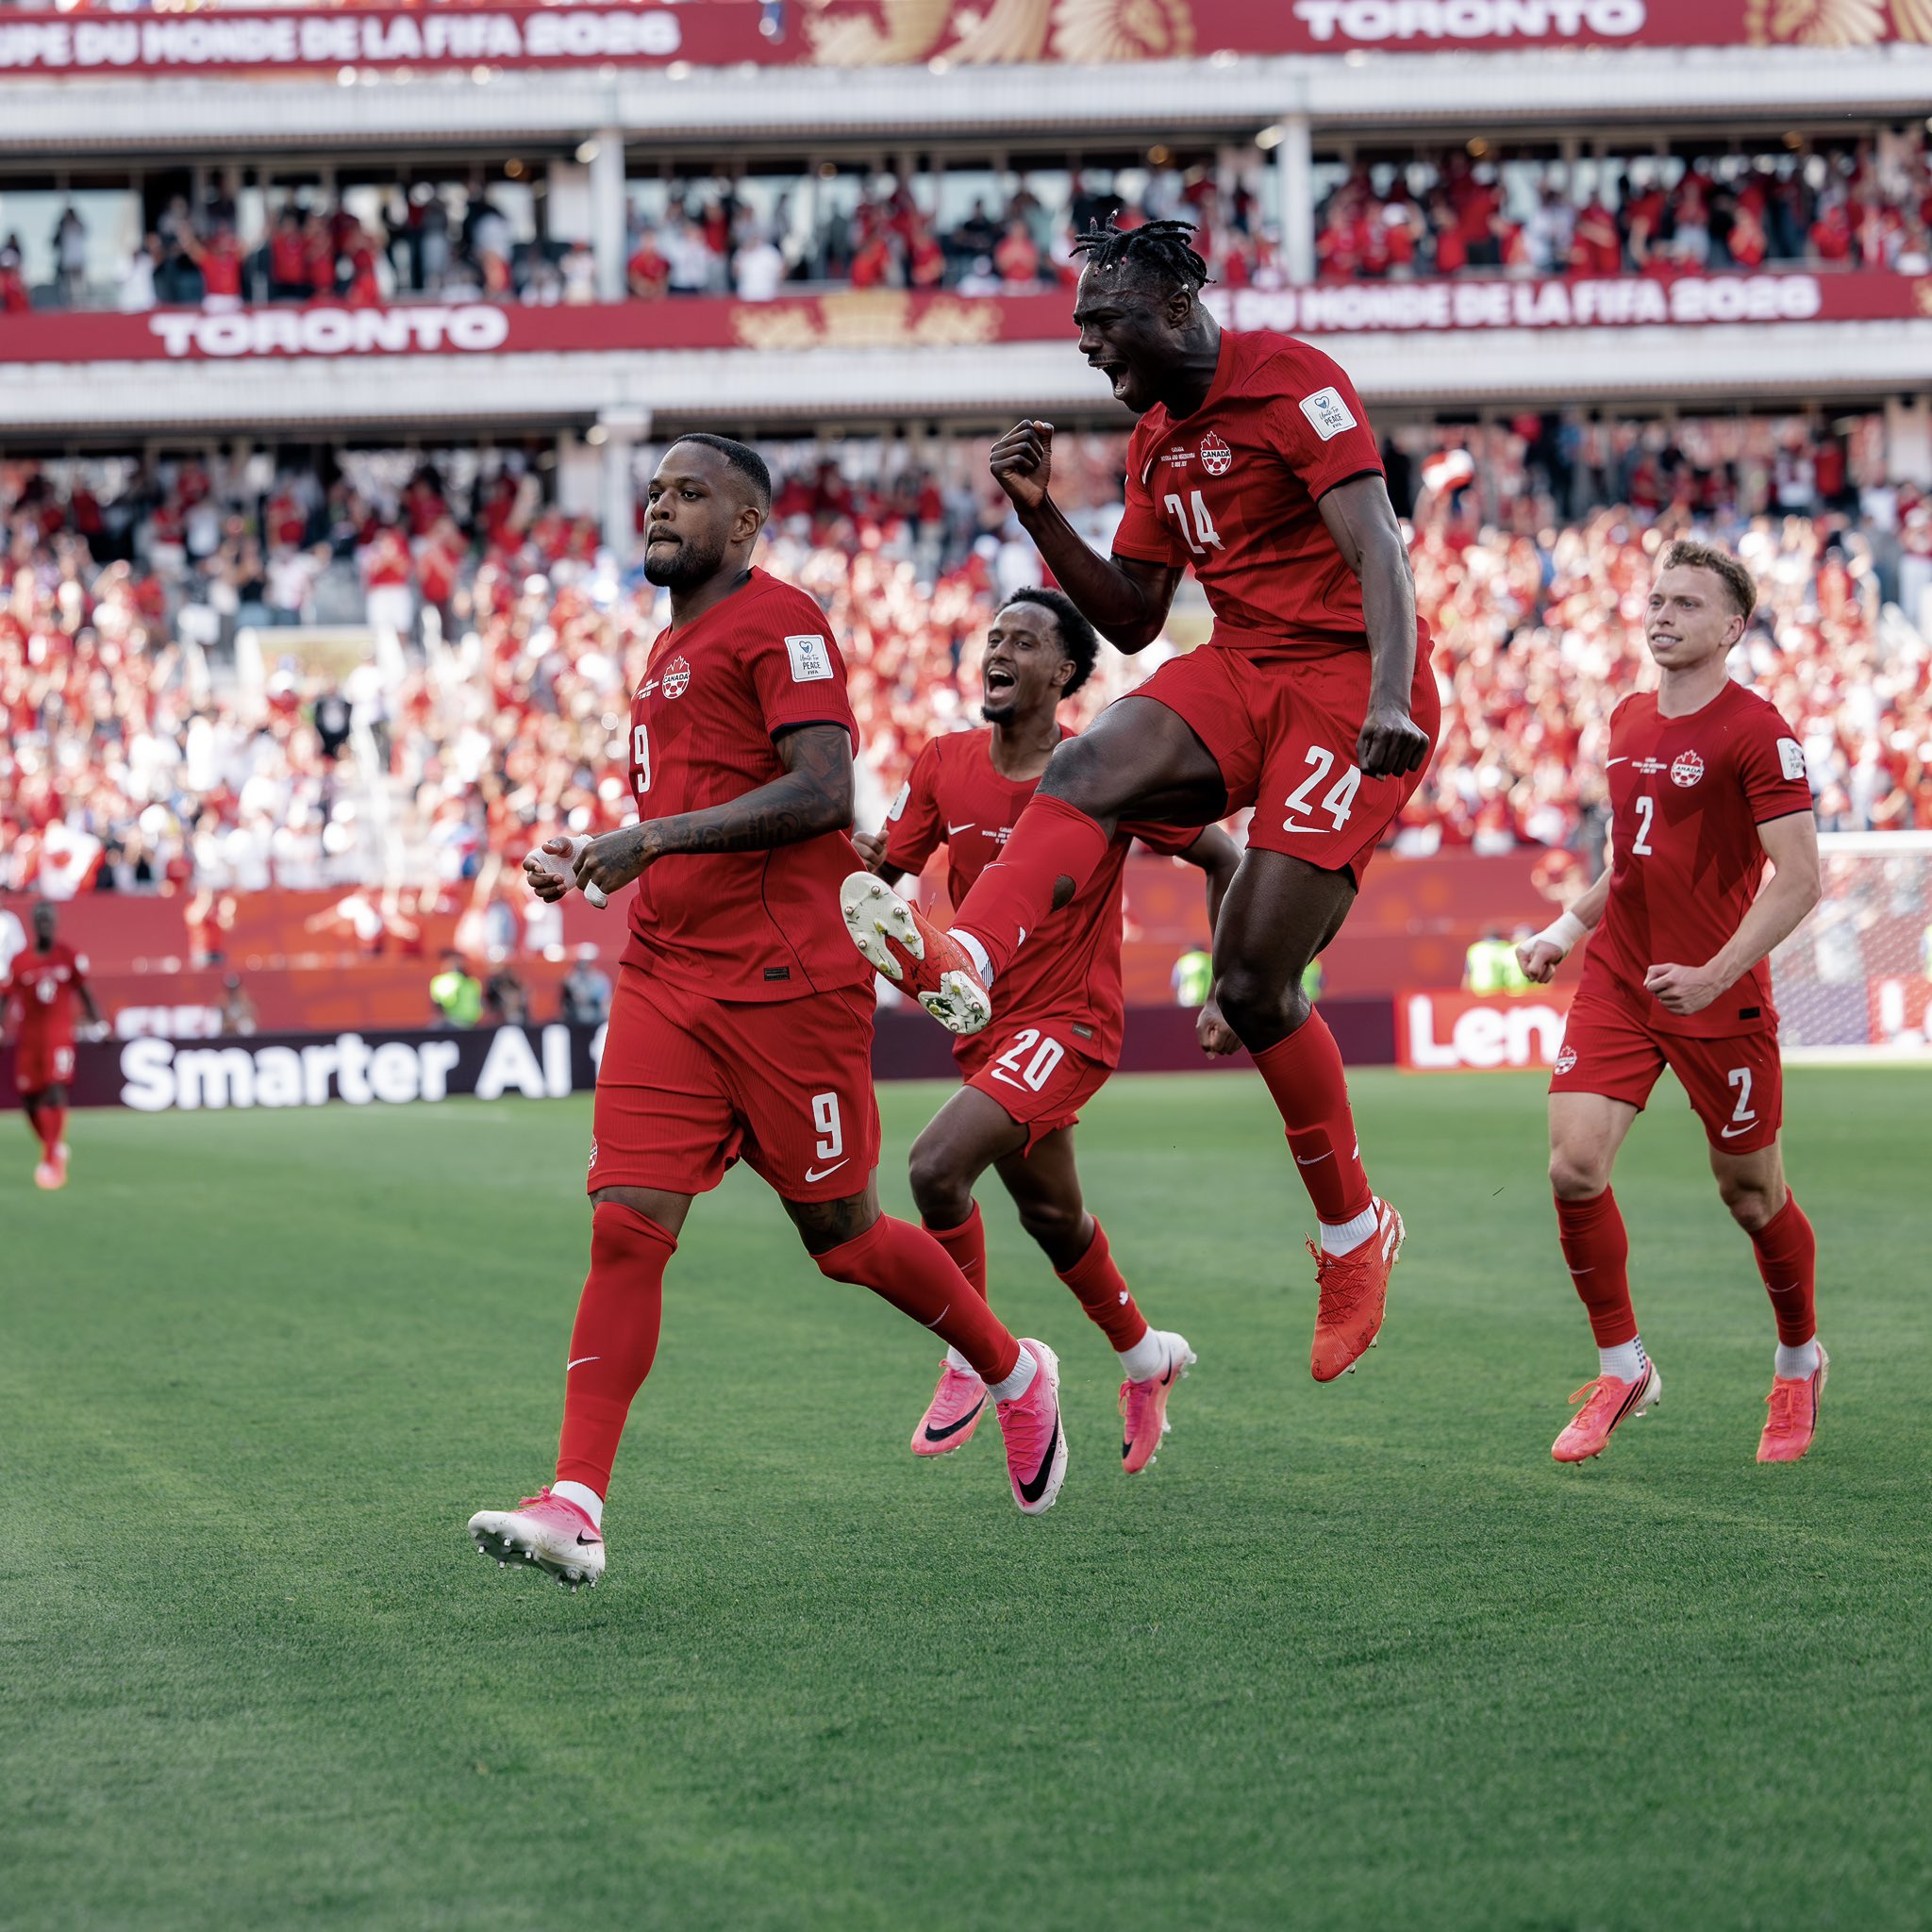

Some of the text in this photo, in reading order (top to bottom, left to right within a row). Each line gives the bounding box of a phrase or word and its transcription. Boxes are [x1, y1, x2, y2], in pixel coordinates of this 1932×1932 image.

[75, 21, 139, 65] DU
[142, 18, 297, 64] MONDE
[300, 16, 359, 61] DE
[362, 15, 422, 59] LA
[424, 13, 522, 58] FIFA
[525, 11, 681, 57] 2026
[1295, 0, 1646, 41] TORONTO
[1234, 289, 1297, 332] DU
[1301, 284, 1450, 330] MONDE
[1454, 282, 1511, 327] DE
[1513, 281, 1571, 325] LA
[1572, 279, 1667, 324] FIFA
[1670, 275, 1822, 323] 2026
[151, 307, 508, 358] TORONTO
[1324, 413, 1342, 425] PEACE
[1201, 450, 1230, 458] CANADA
[1163, 490, 1225, 555] 24
[663, 673, 689, 683] CANADA
[803, 661, 821, 670] PEACE
[634, 724, 651, 793] 9
[1284, 745, 1361, 832] 24
[1632, 795, 1654, 856] 2
[996, 1028, 1065, 1091] 20
[1408, 994, 1569, 1069] Len
[120, 1032, 459, 1111] Smarter
[475, 1024, 573, 1099] AI
[1728, 1067, 1756, 1122] 2
[812, 1091, 842, 1159] 9
